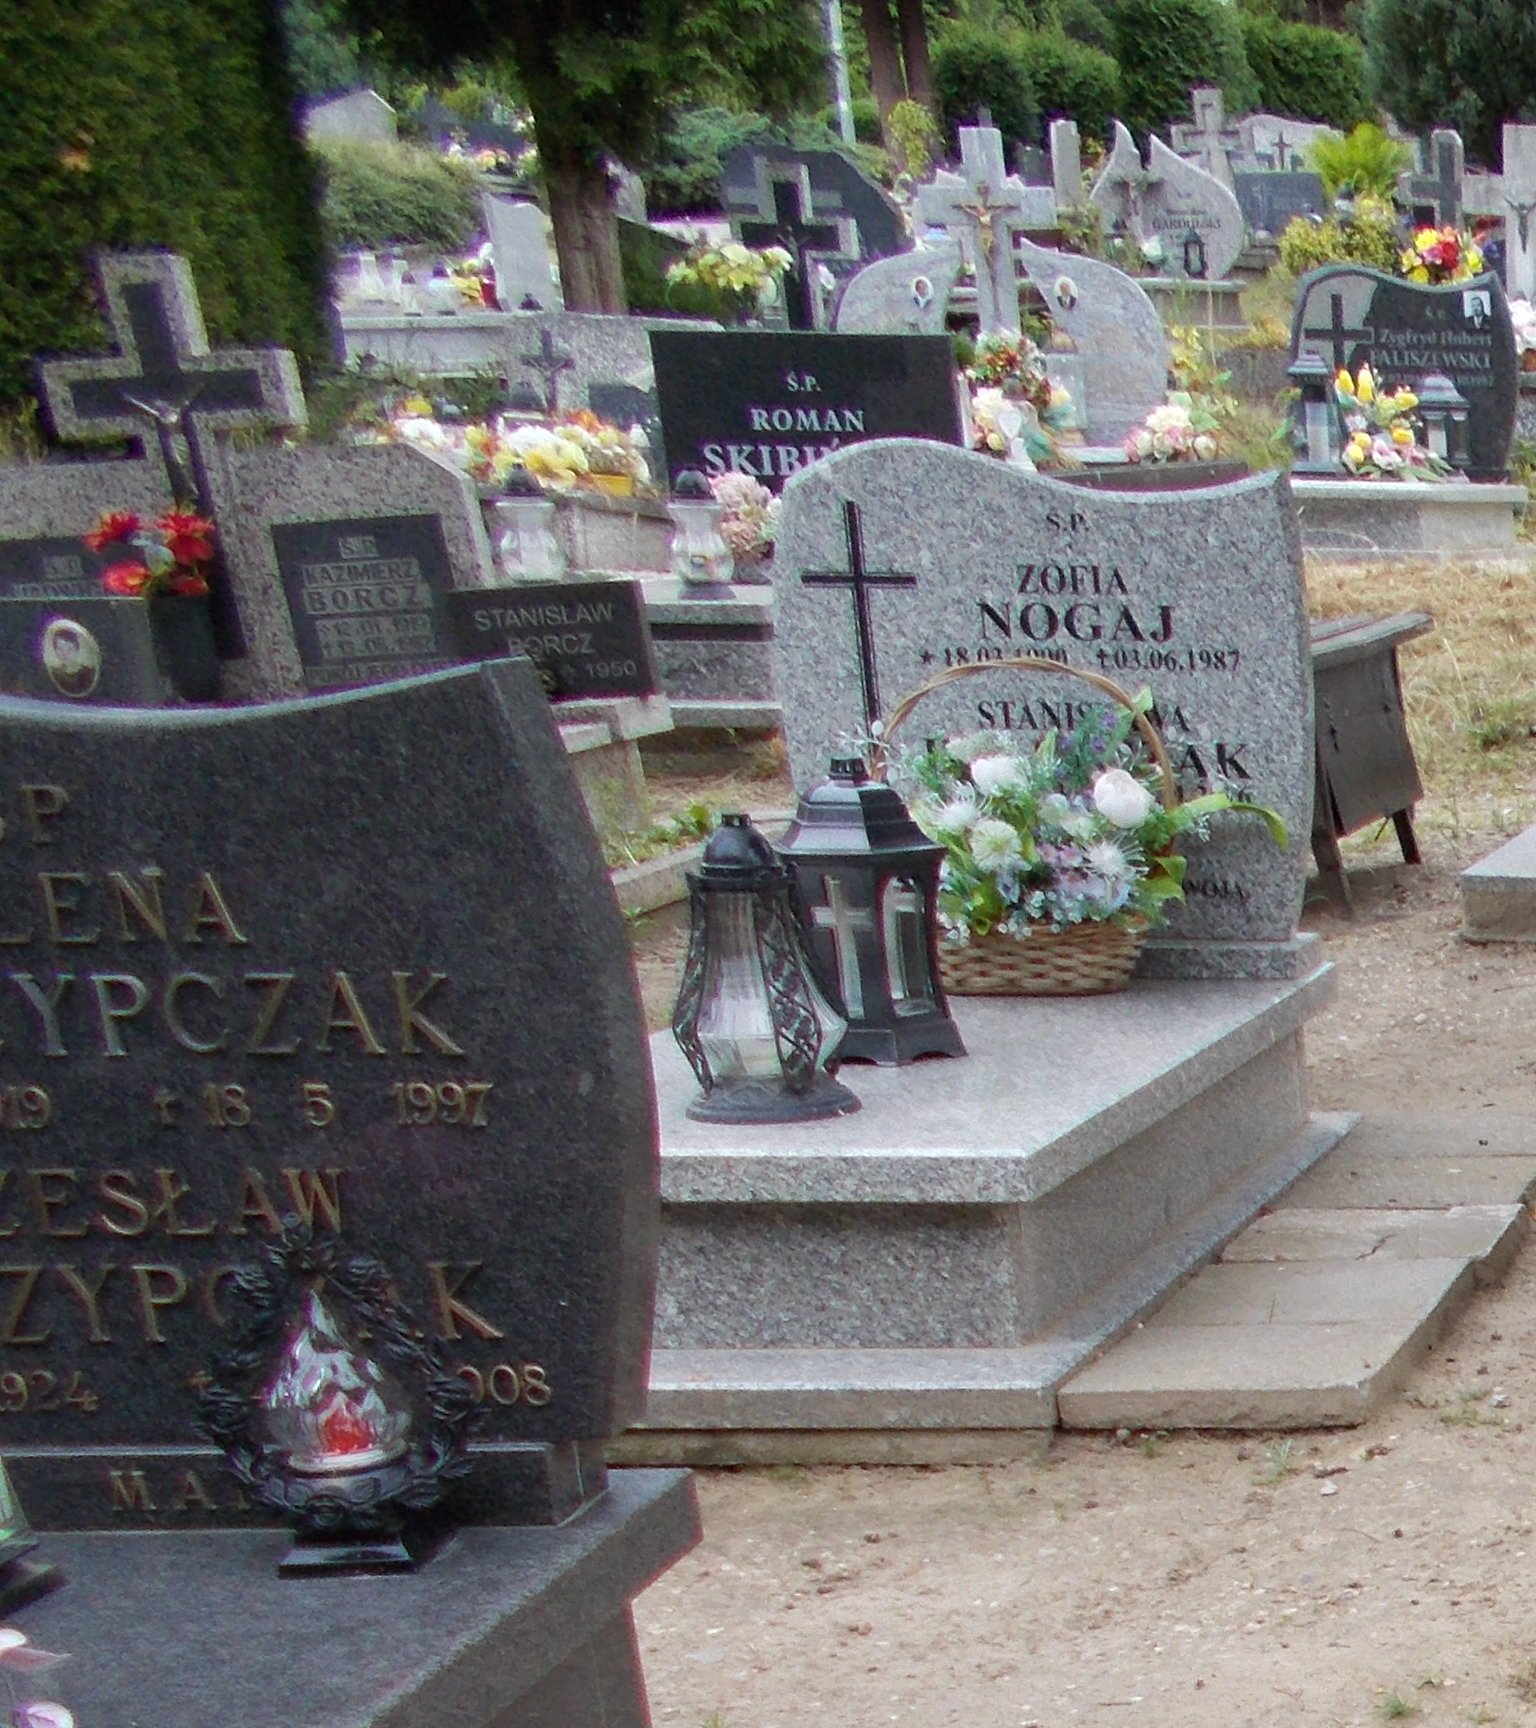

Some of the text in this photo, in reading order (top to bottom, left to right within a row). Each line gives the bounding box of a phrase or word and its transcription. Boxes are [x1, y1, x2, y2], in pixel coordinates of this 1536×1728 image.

[751, 407, 866, 433] ROMAN
[1015, 562, 1130, 596] ZOFIA
[306, 585, 424, 614] BORCZ
[976, 601, 1176, 644] NOGAJ
[202, 1083, 252, 1128] 18
[392, 1081, 495, 1128] 1997
